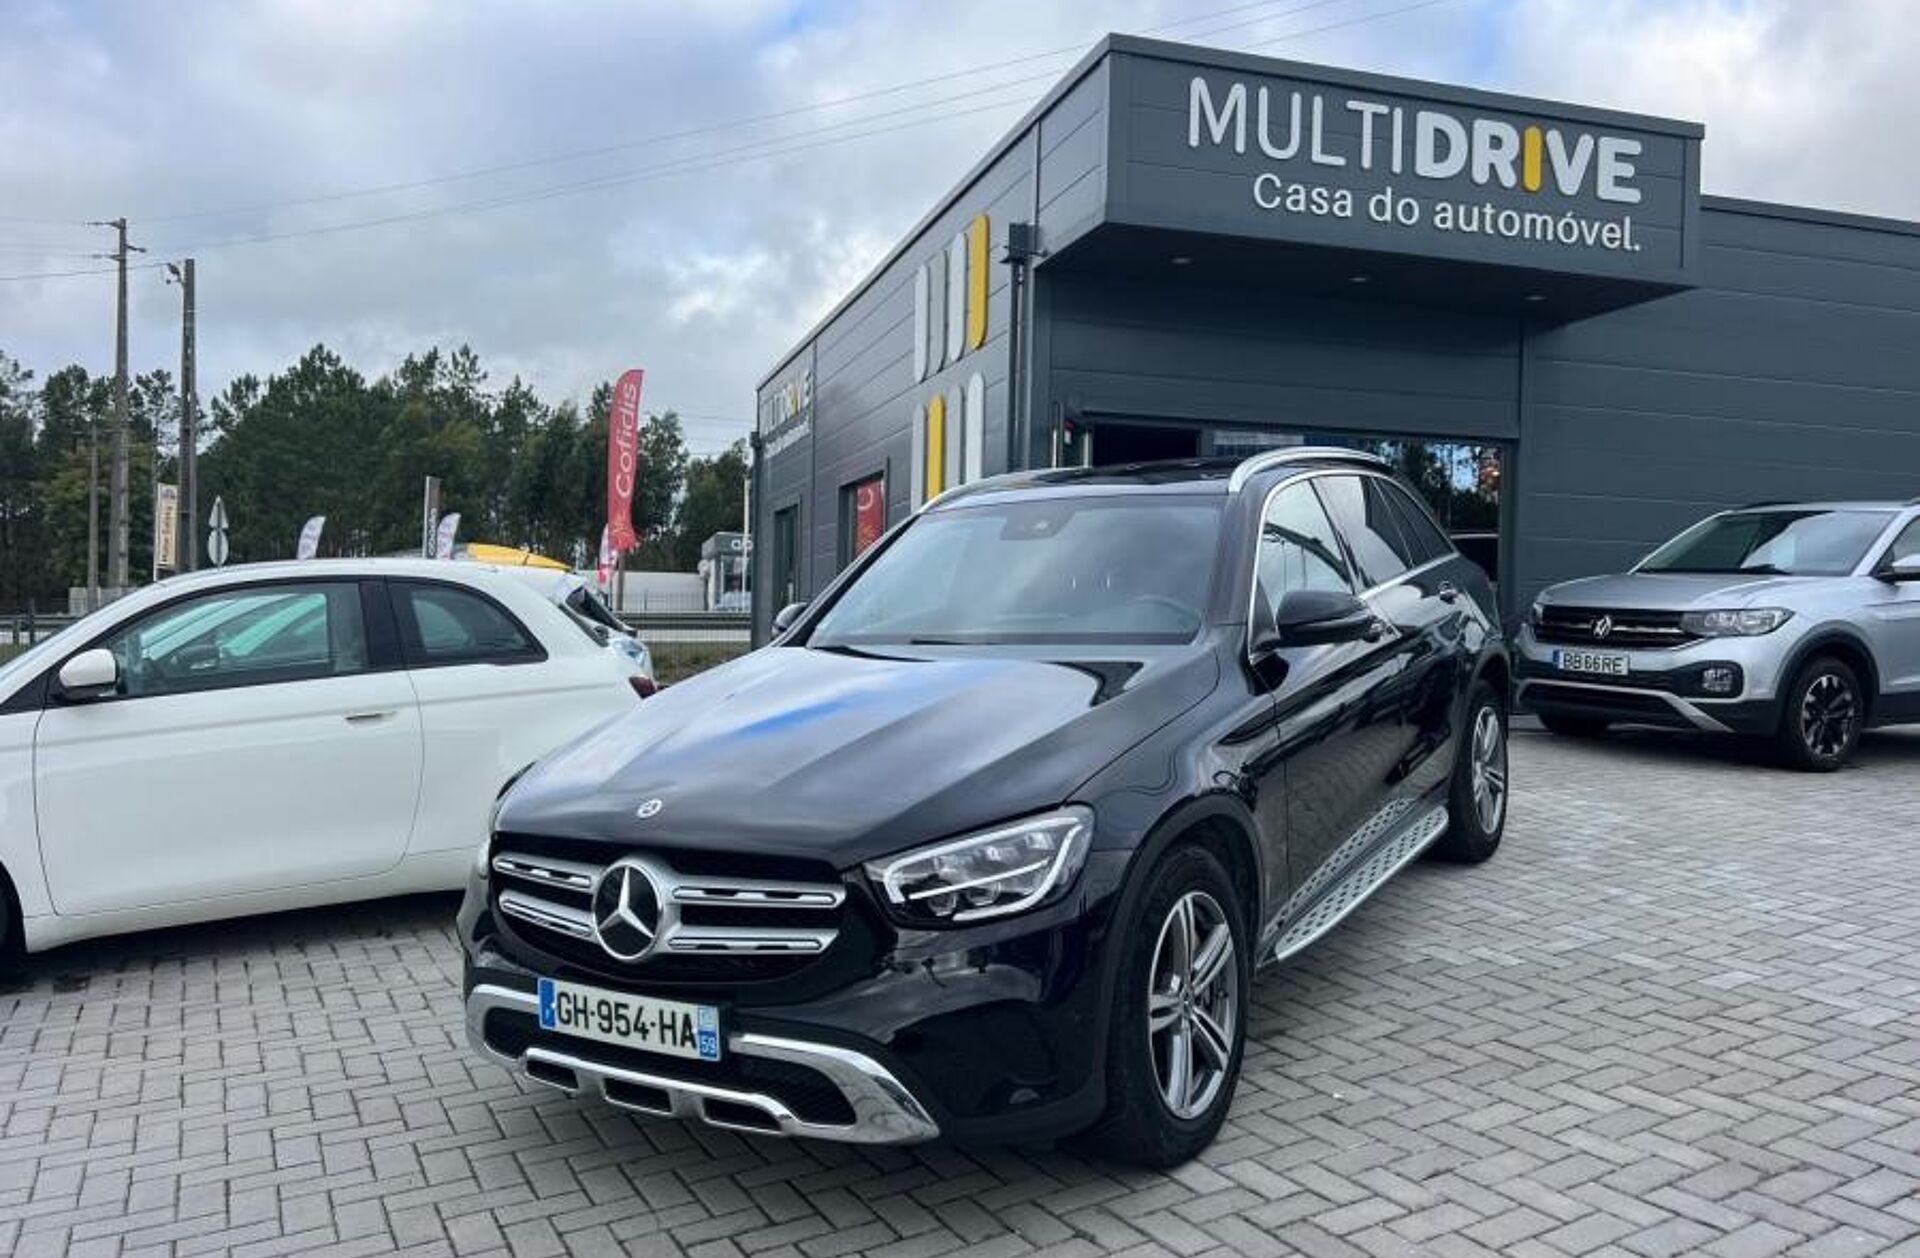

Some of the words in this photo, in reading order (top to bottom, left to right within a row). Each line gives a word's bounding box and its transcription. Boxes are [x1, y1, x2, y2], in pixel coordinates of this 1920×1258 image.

[1187, 76, 1642, 202] MULTIDRIVE
[1253, 172, 1353, 218] Casa
[1369, 186, 1420, 225] do
[1433, 200, 1641, 252] automóvel.
[616, 383, 637, 498] Cofidis
[557, 992, 696, 1049] GH-954-HA
